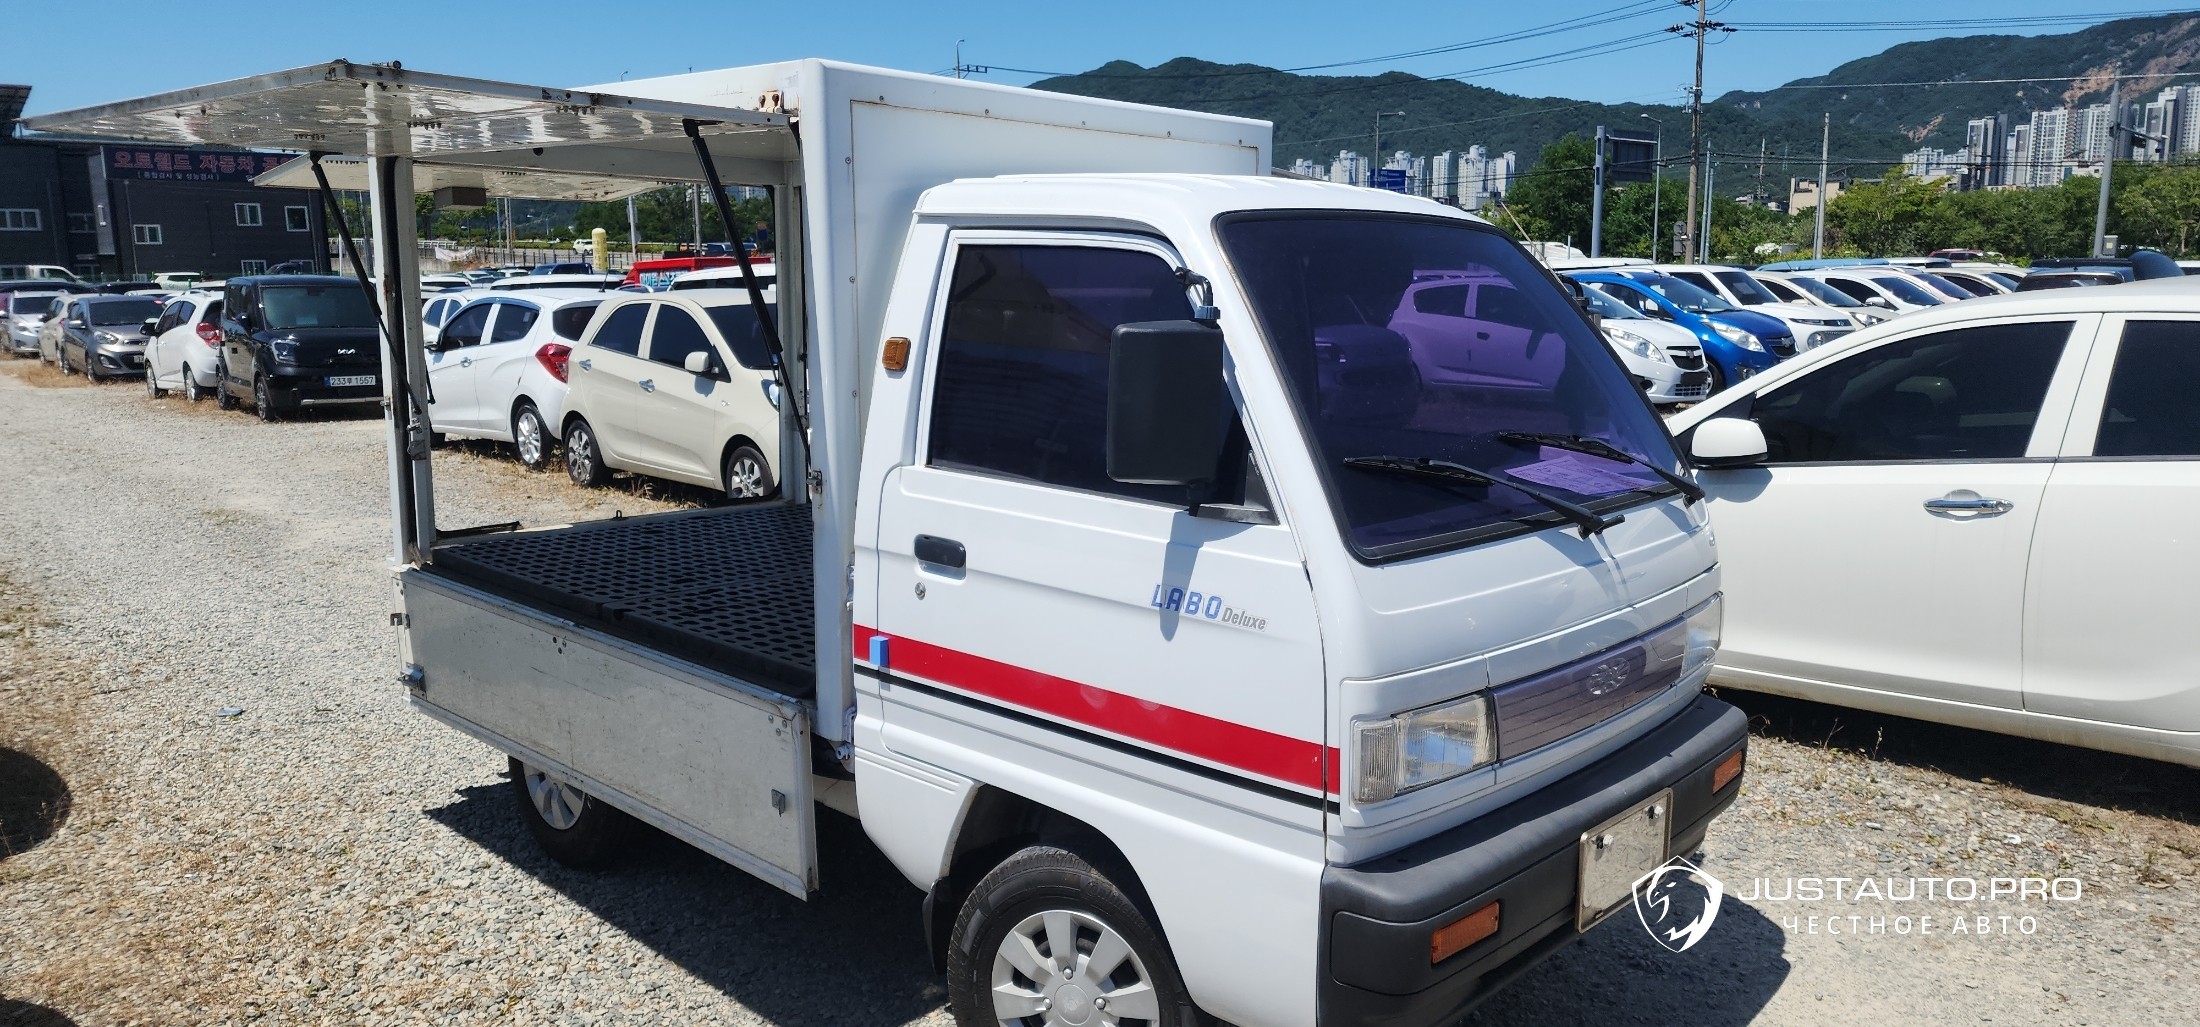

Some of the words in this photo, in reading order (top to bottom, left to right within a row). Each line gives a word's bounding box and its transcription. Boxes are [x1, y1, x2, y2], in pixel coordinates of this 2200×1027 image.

[114, 152, 192, 170] 오토월드
[199, 155, 255, 174] 자동차
[1151, 584, 1222, 619] LABO
[1222, 607, 1266, 631] Deluxe
